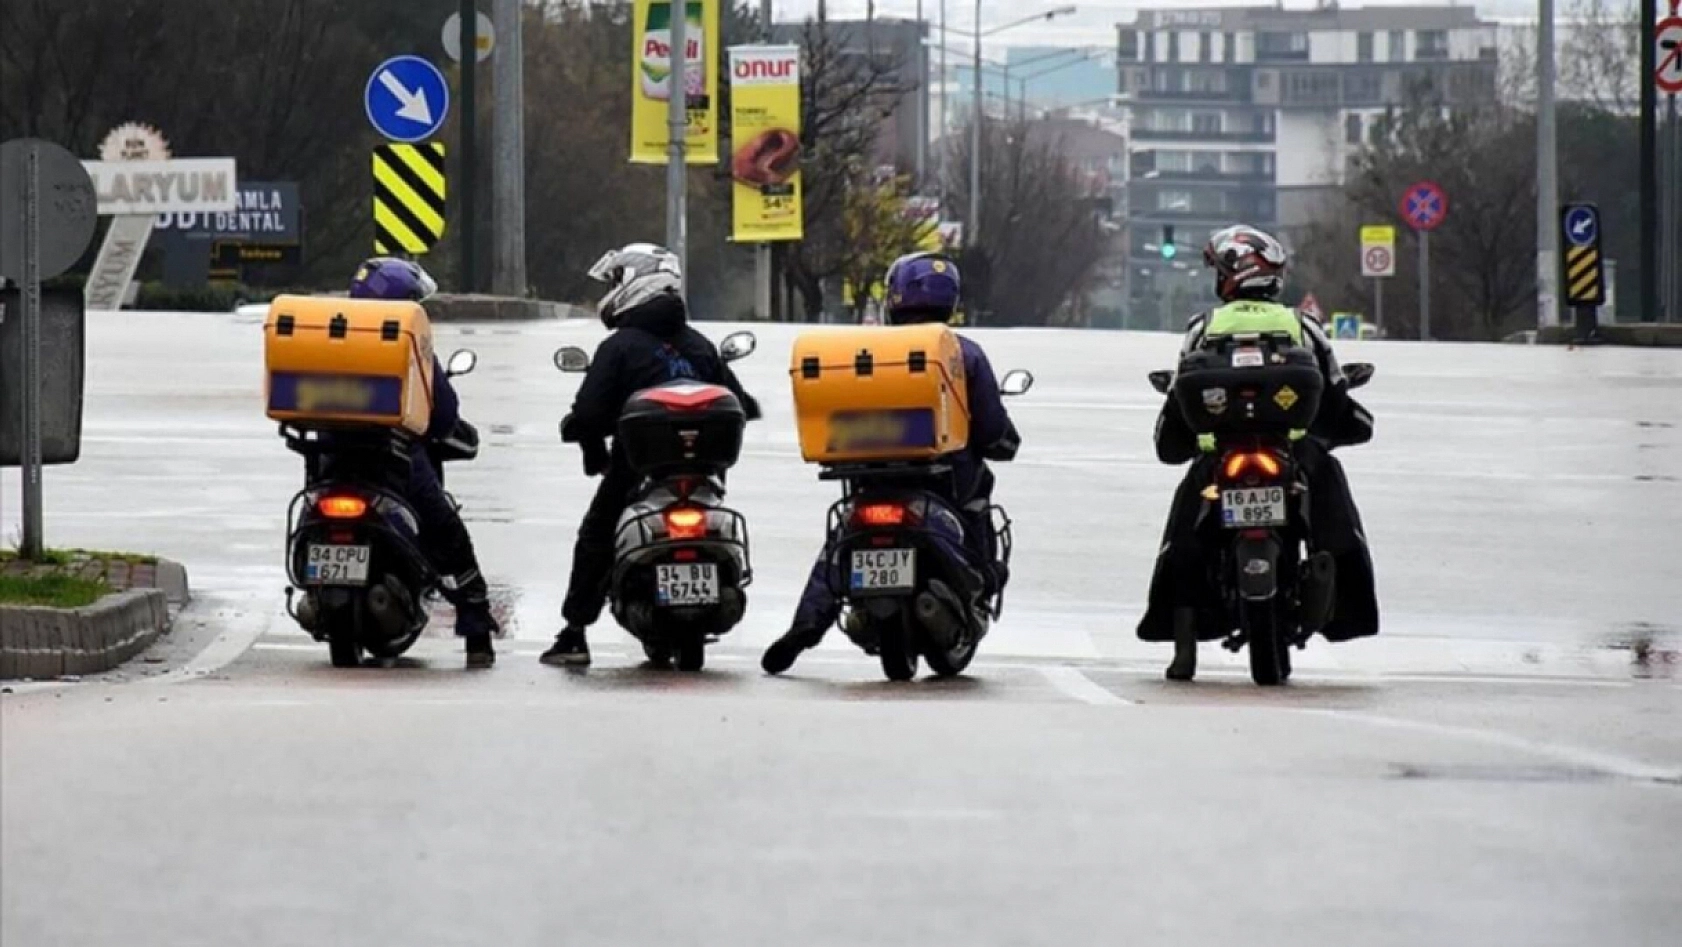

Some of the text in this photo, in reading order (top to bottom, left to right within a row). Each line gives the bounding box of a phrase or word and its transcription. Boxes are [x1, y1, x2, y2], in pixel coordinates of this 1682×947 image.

[645, 39, 699, 58] Peil
[735, 58, 796, 78] onur
[215, 211, 285, 231] DENTAL
[1226, 489, 1281, 505] 16 AJG
[1243, 505, 1273, 520] 895
[310, 547, 367, 563] 34 CPU
[321, 563, 348, 579] 671
[661, 566, 679, 581] 34
[869, 569, 899, 585] 280
[670, 581, 711, 597] 6744
